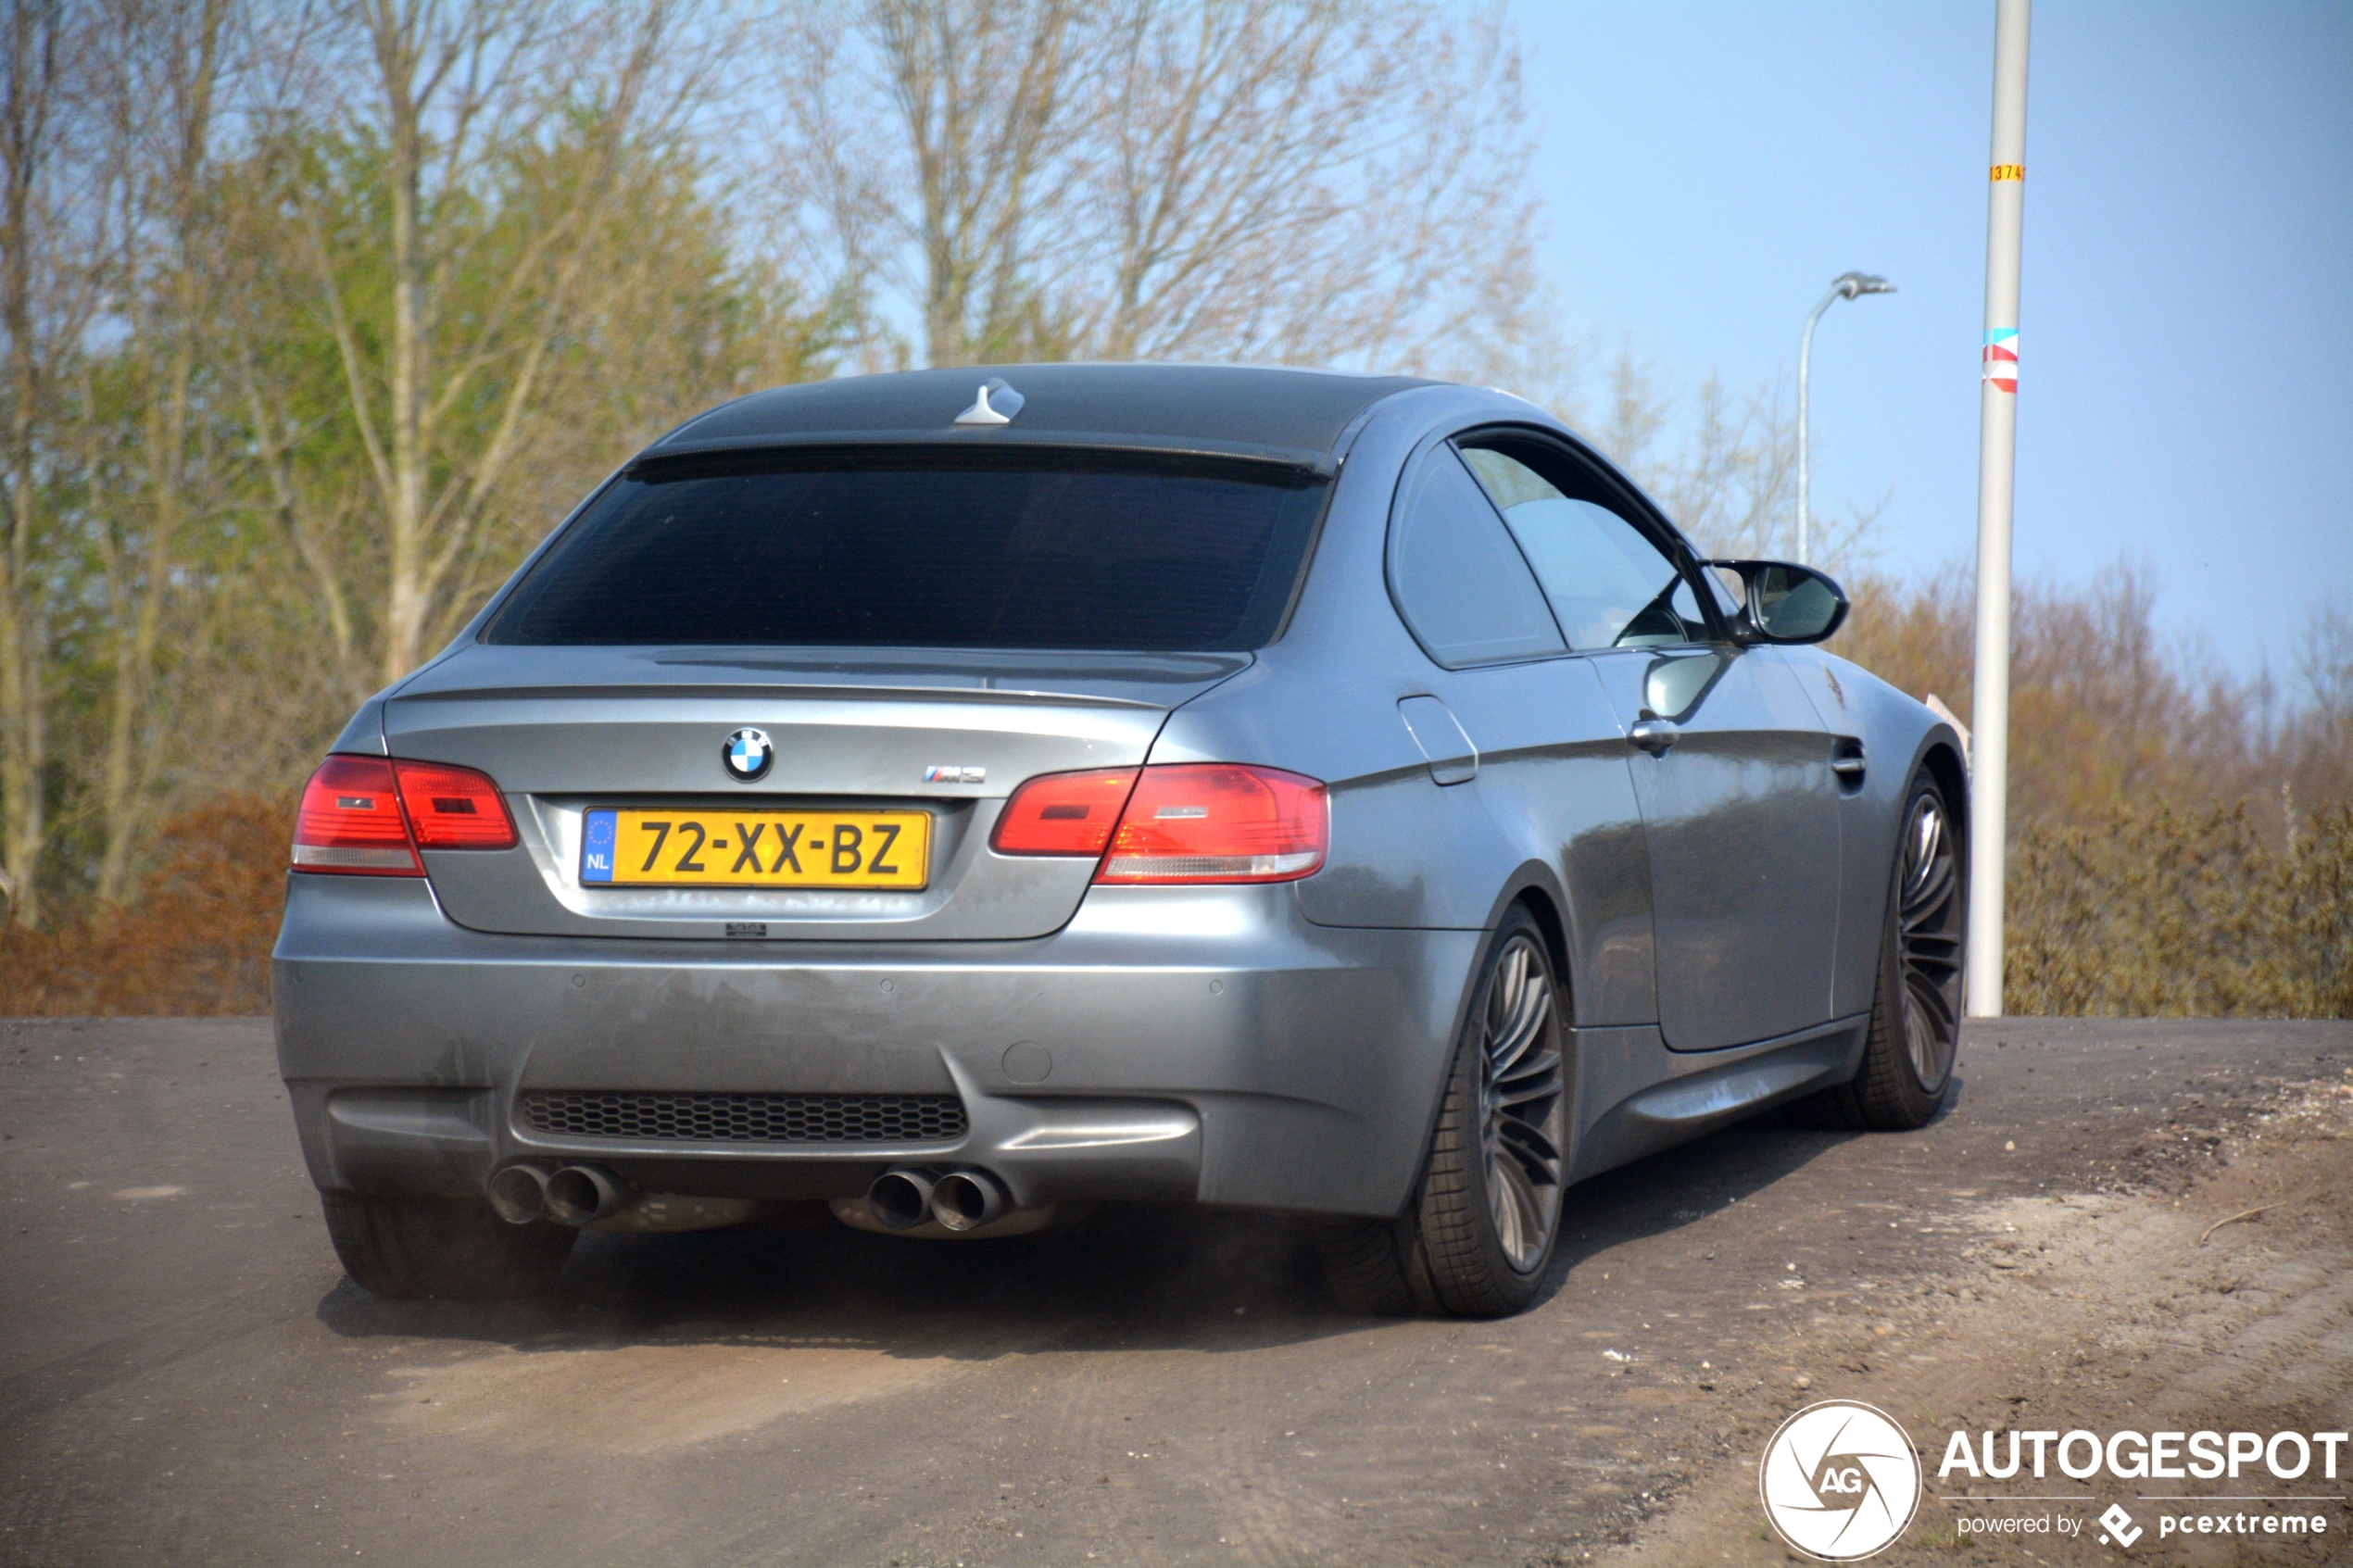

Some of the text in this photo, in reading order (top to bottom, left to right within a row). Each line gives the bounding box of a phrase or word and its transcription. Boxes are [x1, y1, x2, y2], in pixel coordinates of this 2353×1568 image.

[726, 729, 770, 747] BMW
[640, 821, 901, 874] 72-XX-BZ
[586, 853, 610, 870] NL
